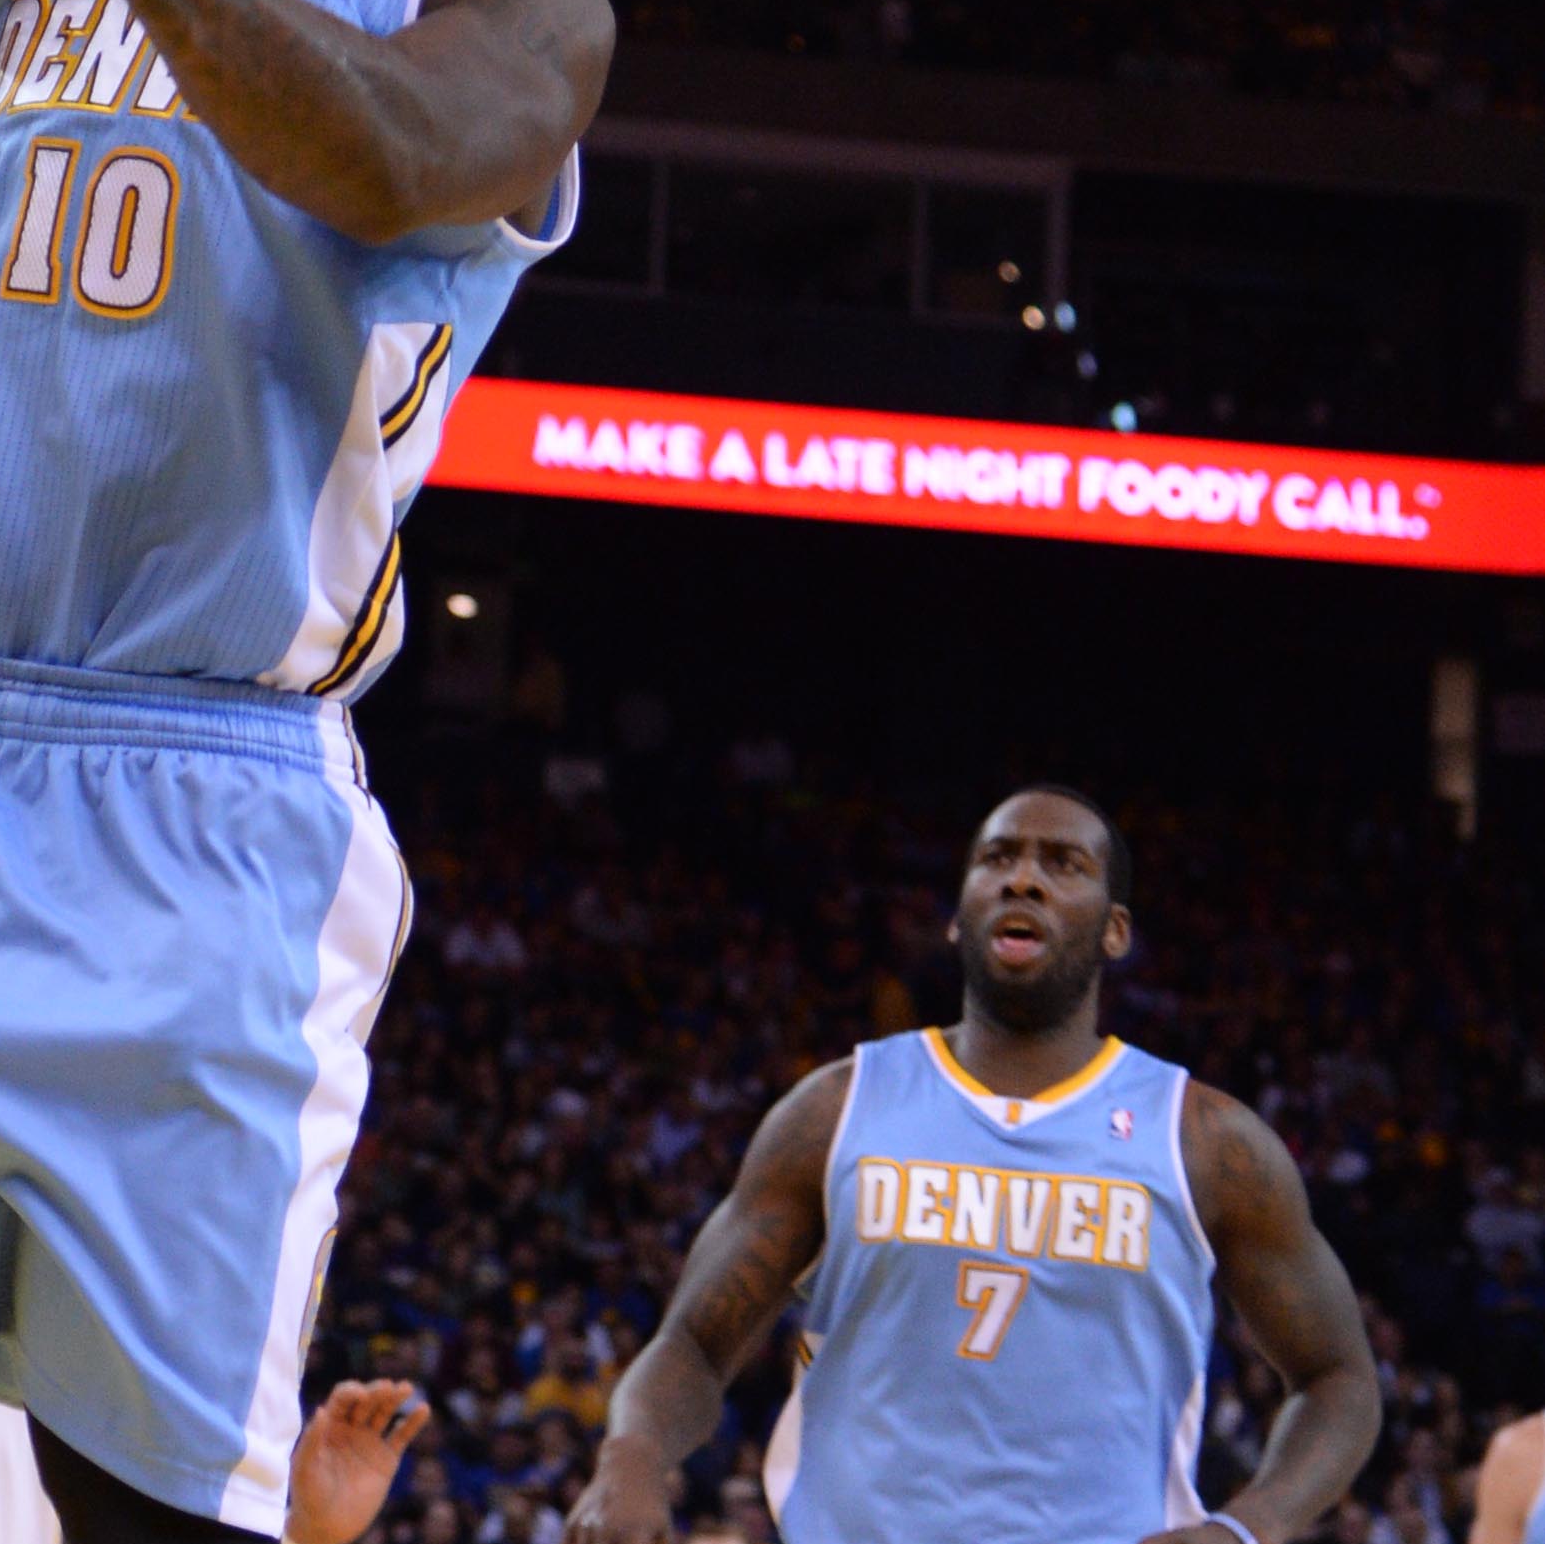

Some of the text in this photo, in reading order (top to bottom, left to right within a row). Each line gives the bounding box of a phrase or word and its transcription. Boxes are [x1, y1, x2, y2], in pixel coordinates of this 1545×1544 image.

[0, 137, 179, 319] 10
[532, 413, 705, 481] MAKE
[708, 428, 757, 484] A
[763, 431, 896, 495] LATE
[903, 444, 1072, 509] NIGHT
[1077, 456, 1271, 525] FOODY
[858, 1157, 1153, 1272] DENVER
[957, 1259, 1029, 1360] 7
